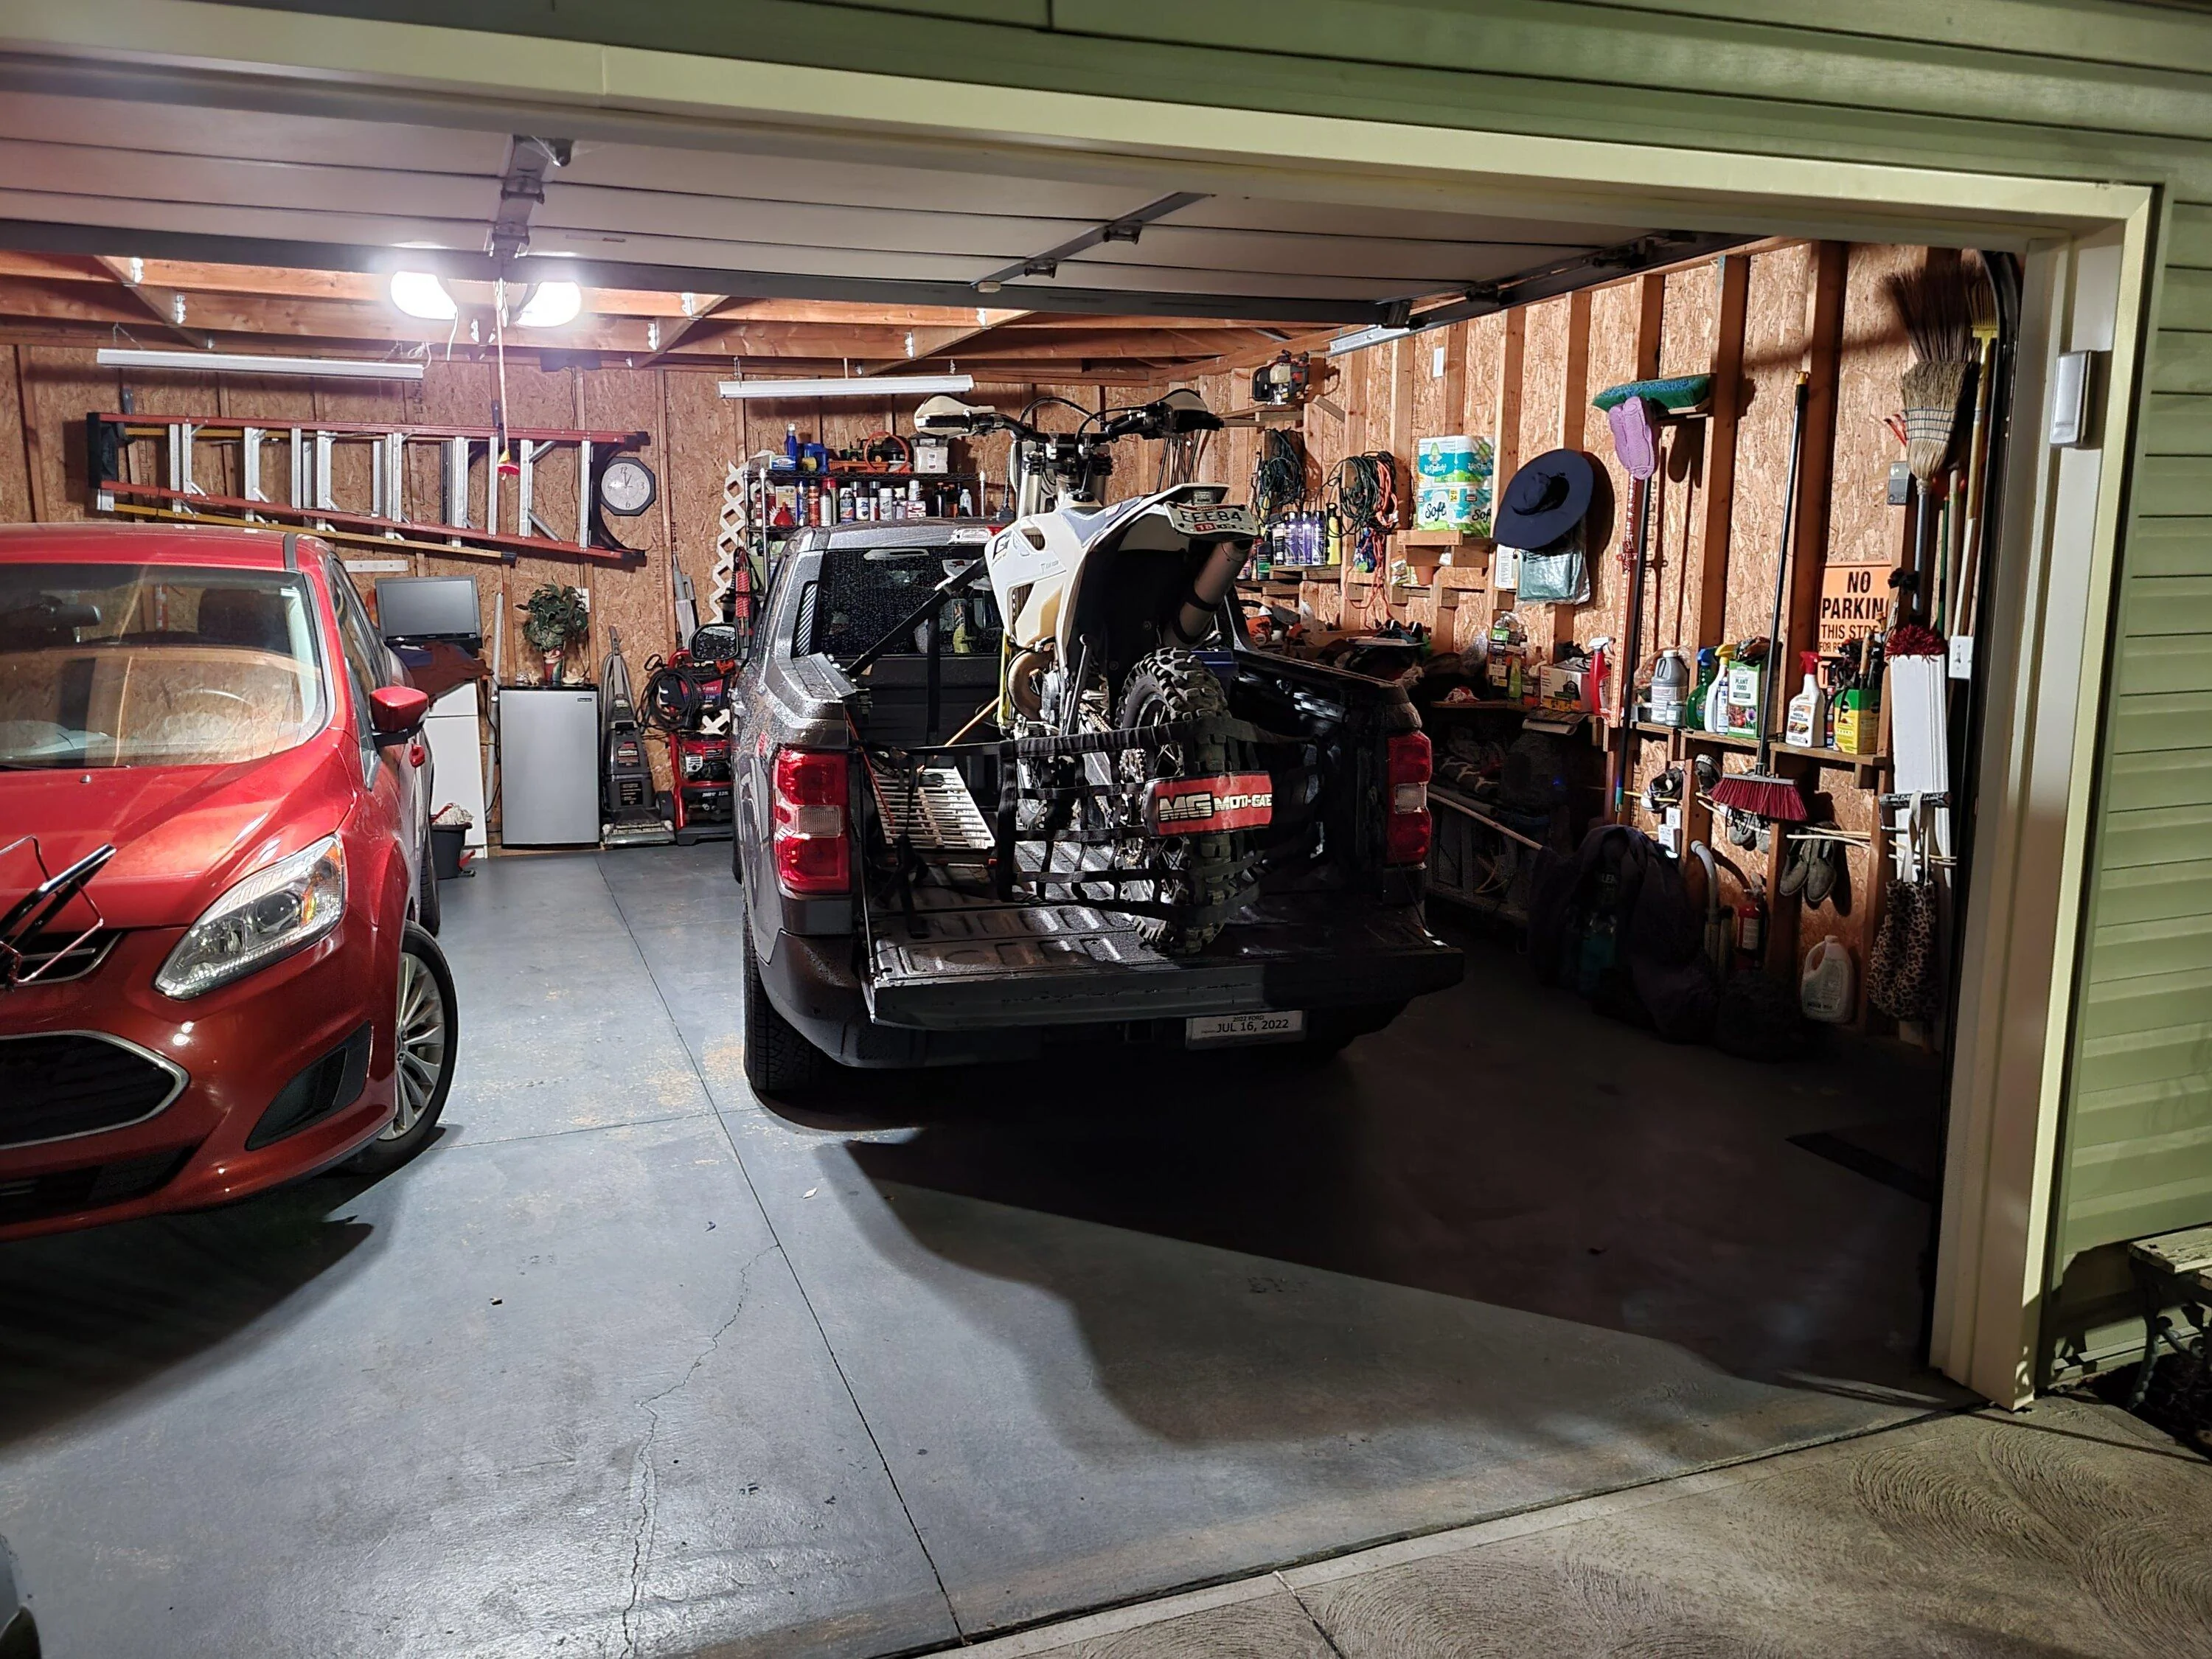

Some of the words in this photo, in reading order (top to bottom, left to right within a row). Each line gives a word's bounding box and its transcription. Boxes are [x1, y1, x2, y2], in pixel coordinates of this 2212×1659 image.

[1425, 501, 1447, 521] Soft
[1472, 507, 1492, 523] Sof
[1847, 571, 1871, 594] NO
[1820, 624, 1846, 639] THIS
[1818, 641, 1832, 653] FOR
[1217, 1023, 1237, 1033] JUL
[1241, 1021, 1256, 1032] 16,
[1262, 1019, 1289, 1029] 2022
